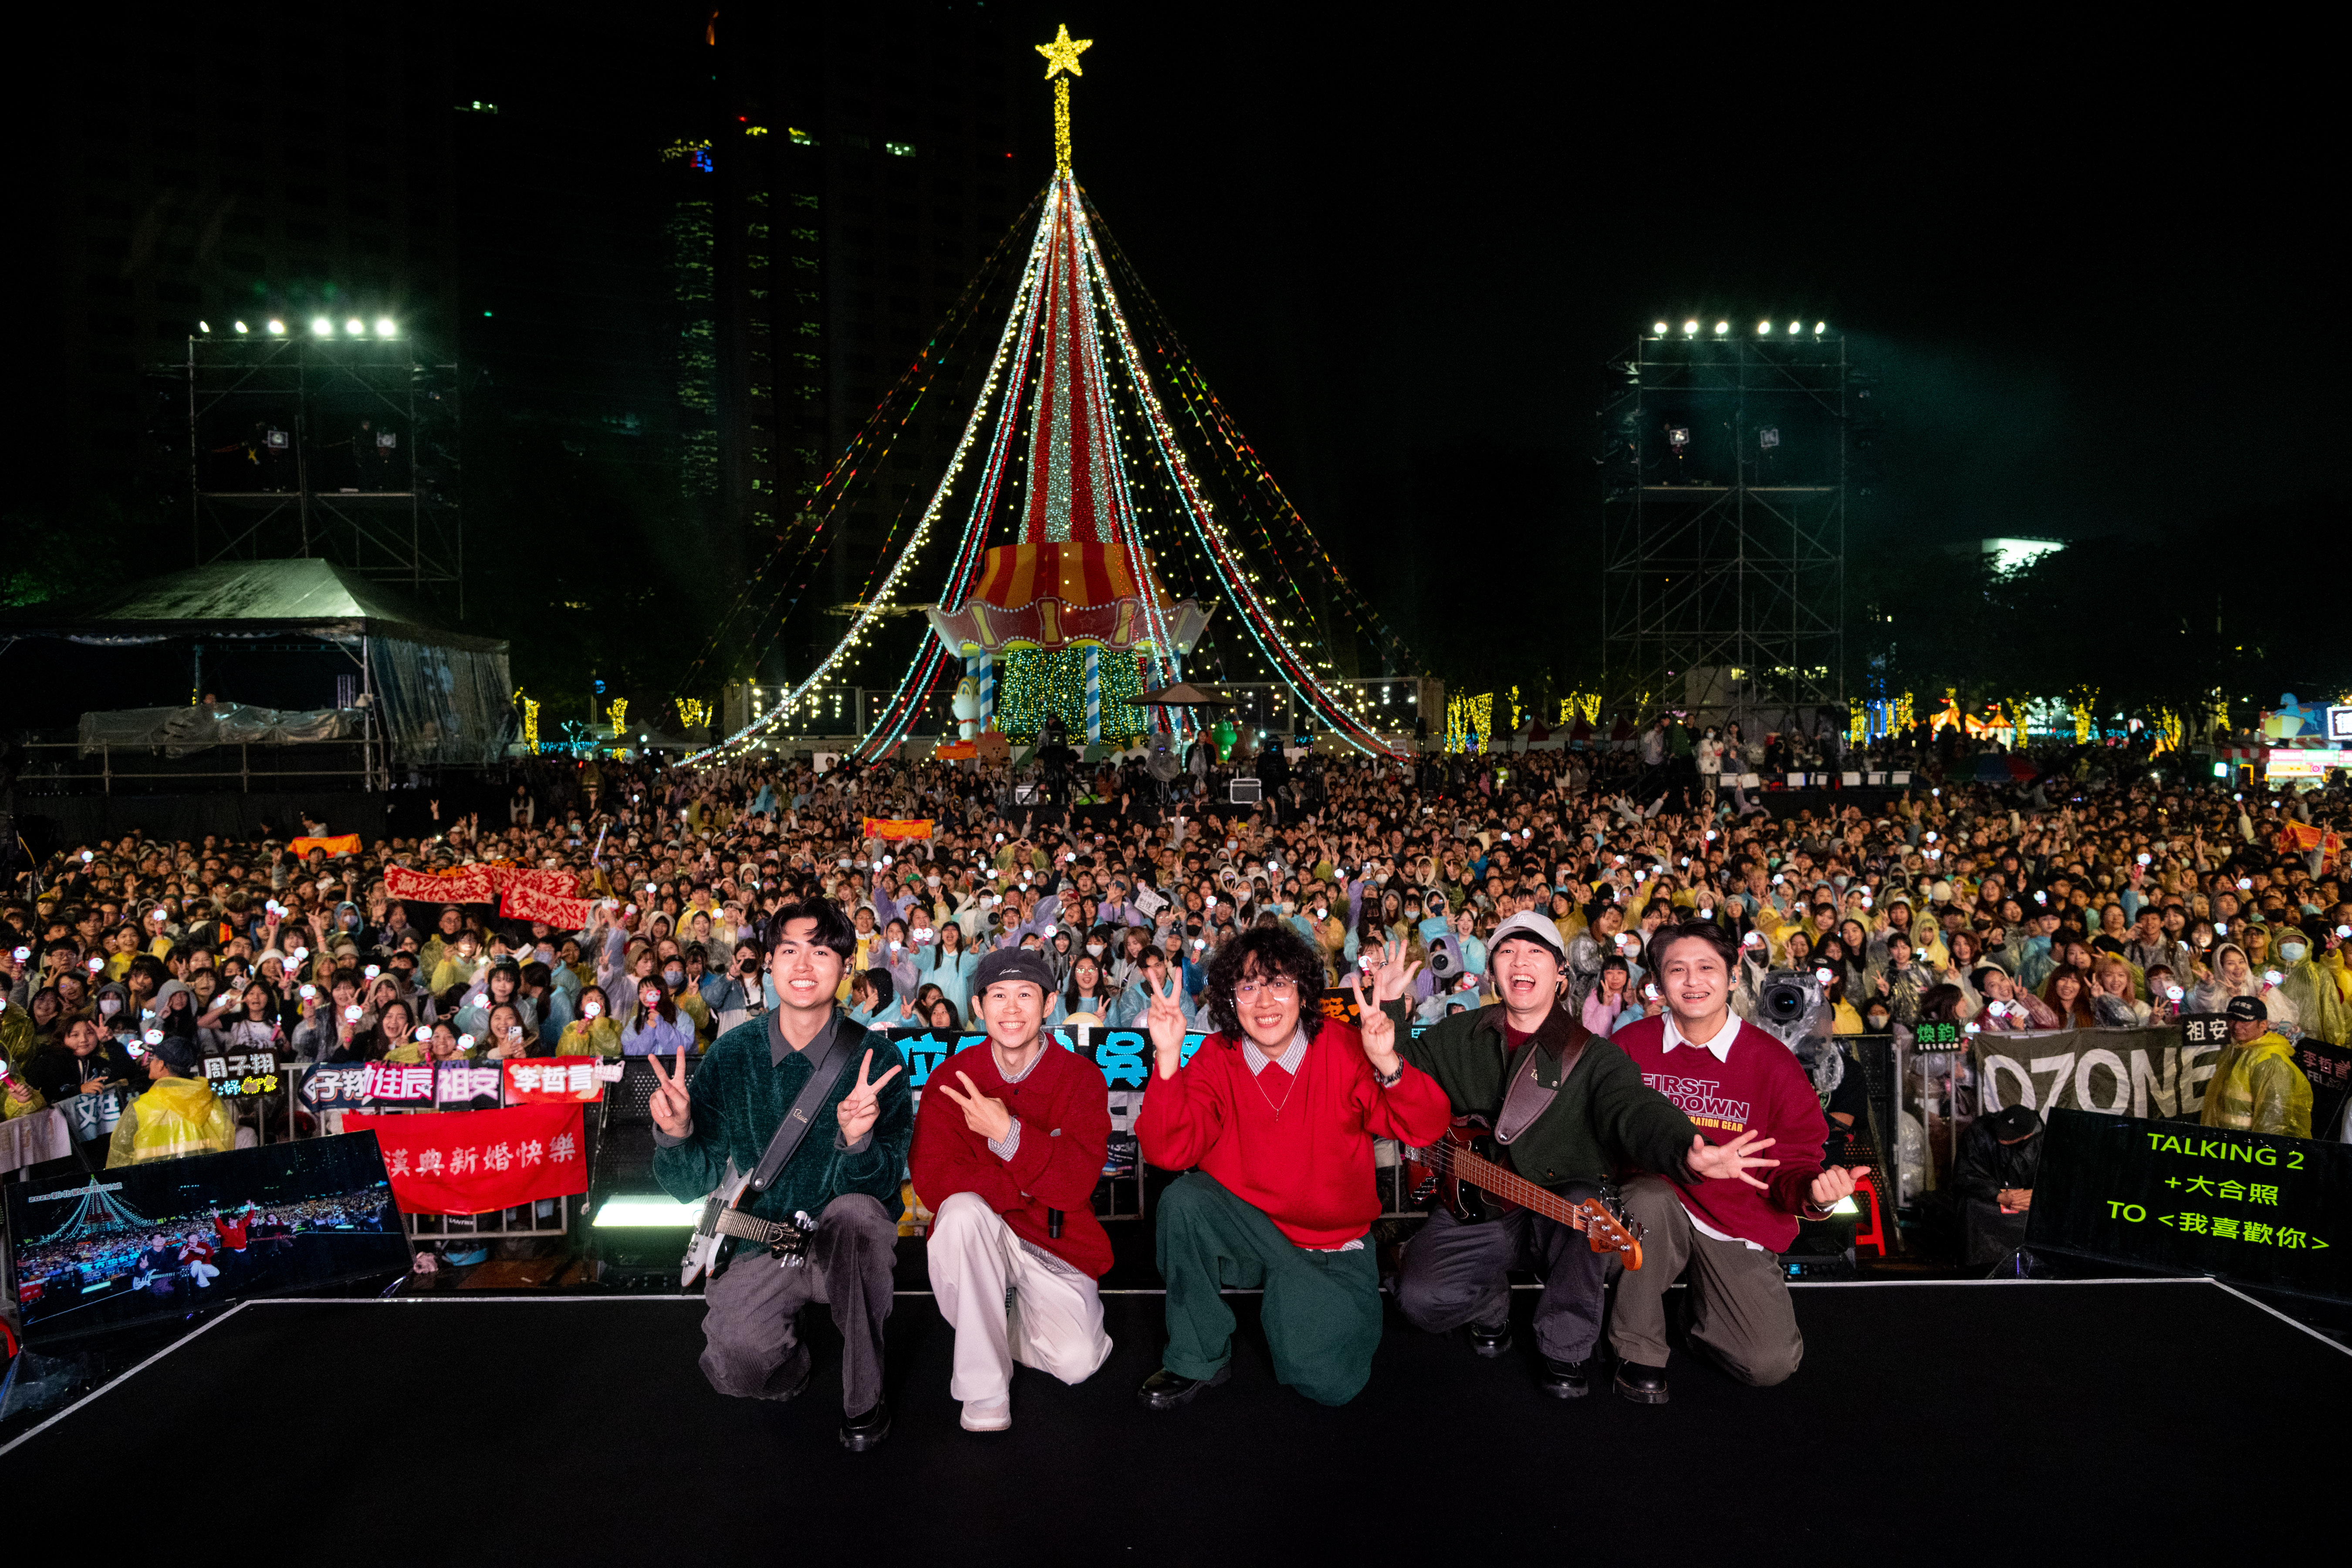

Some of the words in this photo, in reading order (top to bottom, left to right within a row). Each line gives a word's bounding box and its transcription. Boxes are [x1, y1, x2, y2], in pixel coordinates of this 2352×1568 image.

[1516, 914, 1527, 924] LA
[2186, 1018, 2228, 1041] 祖安
[204, 1053, 275, 1079] 周子翔
[514, 1064, 594, 1092] 李哲言
[439, 1068, 500, 1101] 祖安
[1641, 1073, 1719, 1098] FIRST
[1667, 1093, 1750, 1120] DOWN
[1688, 1116, 1719, 1128] RATION
[1721, 1120, 1743, 1132] GEAR
[384, 1132, 576, 1177] 漢典新婚快樂
[2147, 1133, 2277, 1166] TALKING
[2286, 1151, 2304, 1170] 2
[2165, 1176, 2278, 1206] +大合照
[2107, 1200, 2146, 1222] TO
[2158, 1212, 2329, 1250] <我喜歡你>
